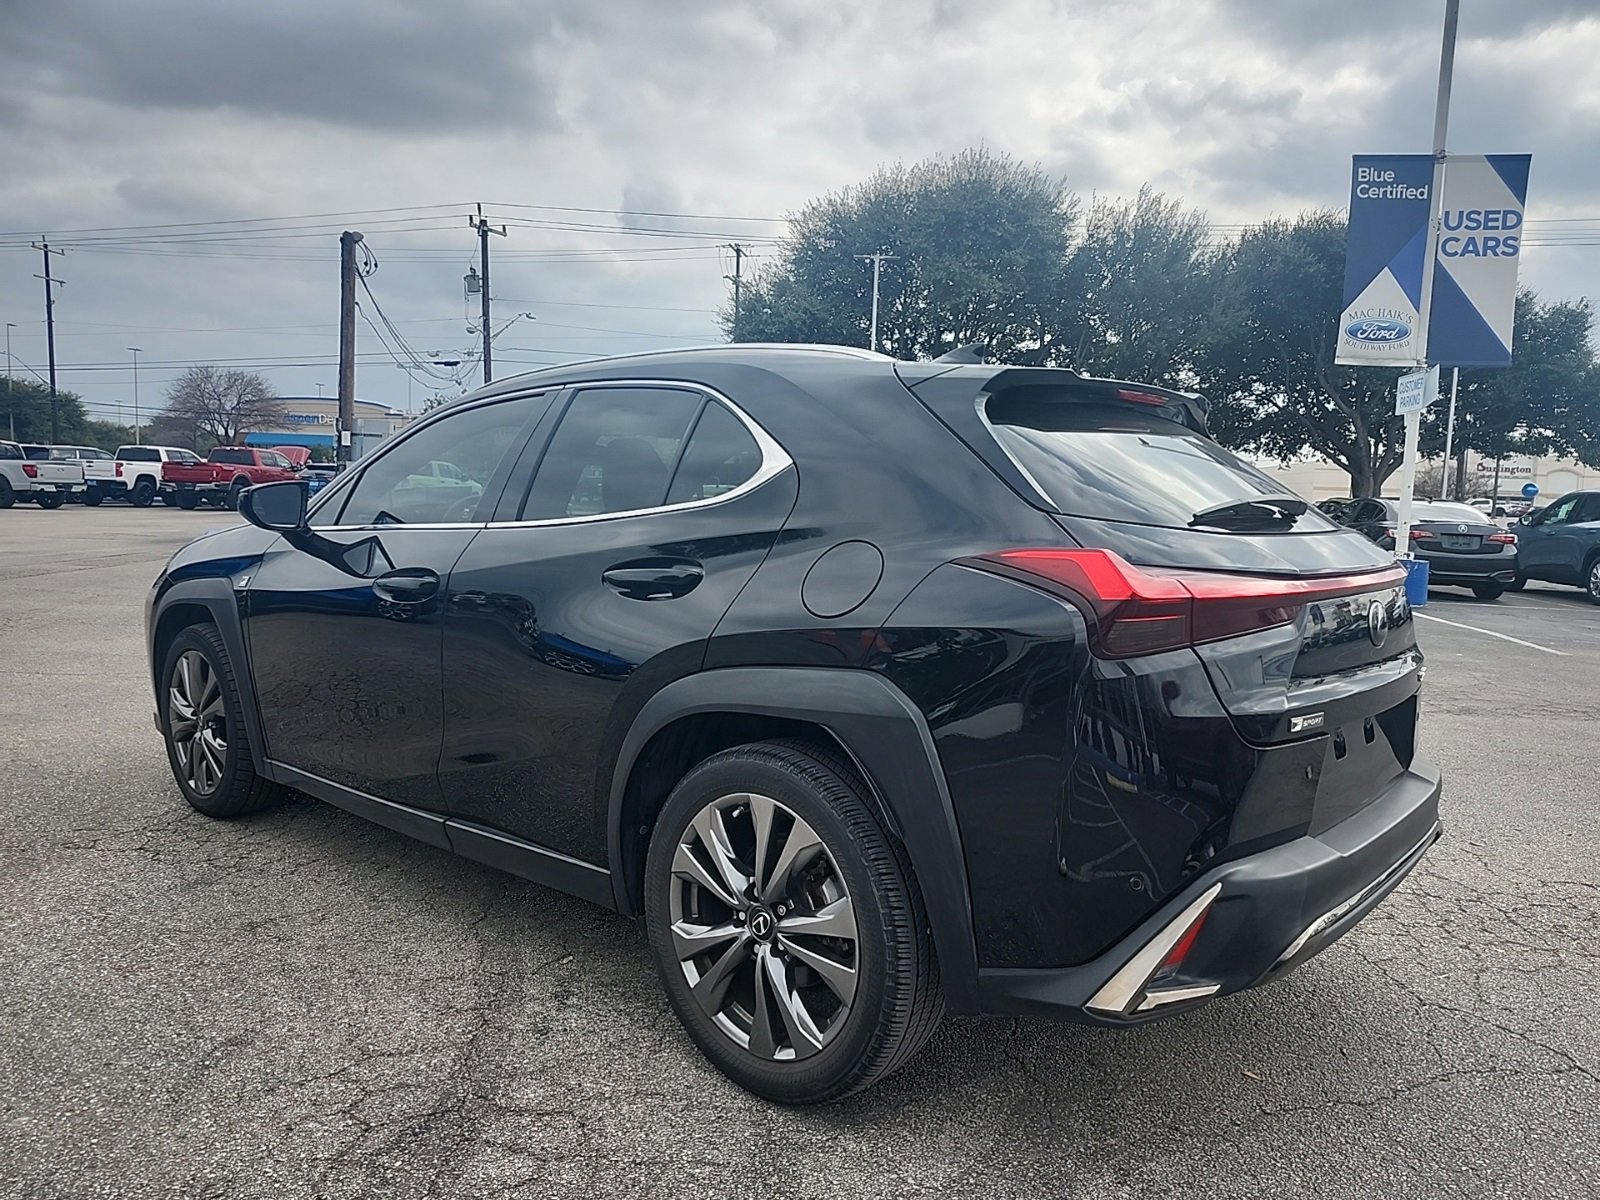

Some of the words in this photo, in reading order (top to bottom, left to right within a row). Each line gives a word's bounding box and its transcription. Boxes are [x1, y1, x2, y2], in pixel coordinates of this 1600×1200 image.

[1358, 167, 1395, 182] Blue
[1356, 184, 1429, 200] Certified
[1443, 209, 1523, 231] USED
[1441, 236, 1519, 257] CARS
[1348, 308, 1375, 322] MAC
[1378, 308, 1414, 324] HAIK'S
[1357, 321, 1400, 339] Ford
[1343, 338, 1387, 352] SOUTHWAY
[1388, 340, 1410, 351] FORD
[1399, 377, 1424, 394] CUSTOMER
[1399, 393, 1421, 408] PARKING
[1476, 462, 1532, 475] Burington
[1303, 716, 1323, 727] SPORT
